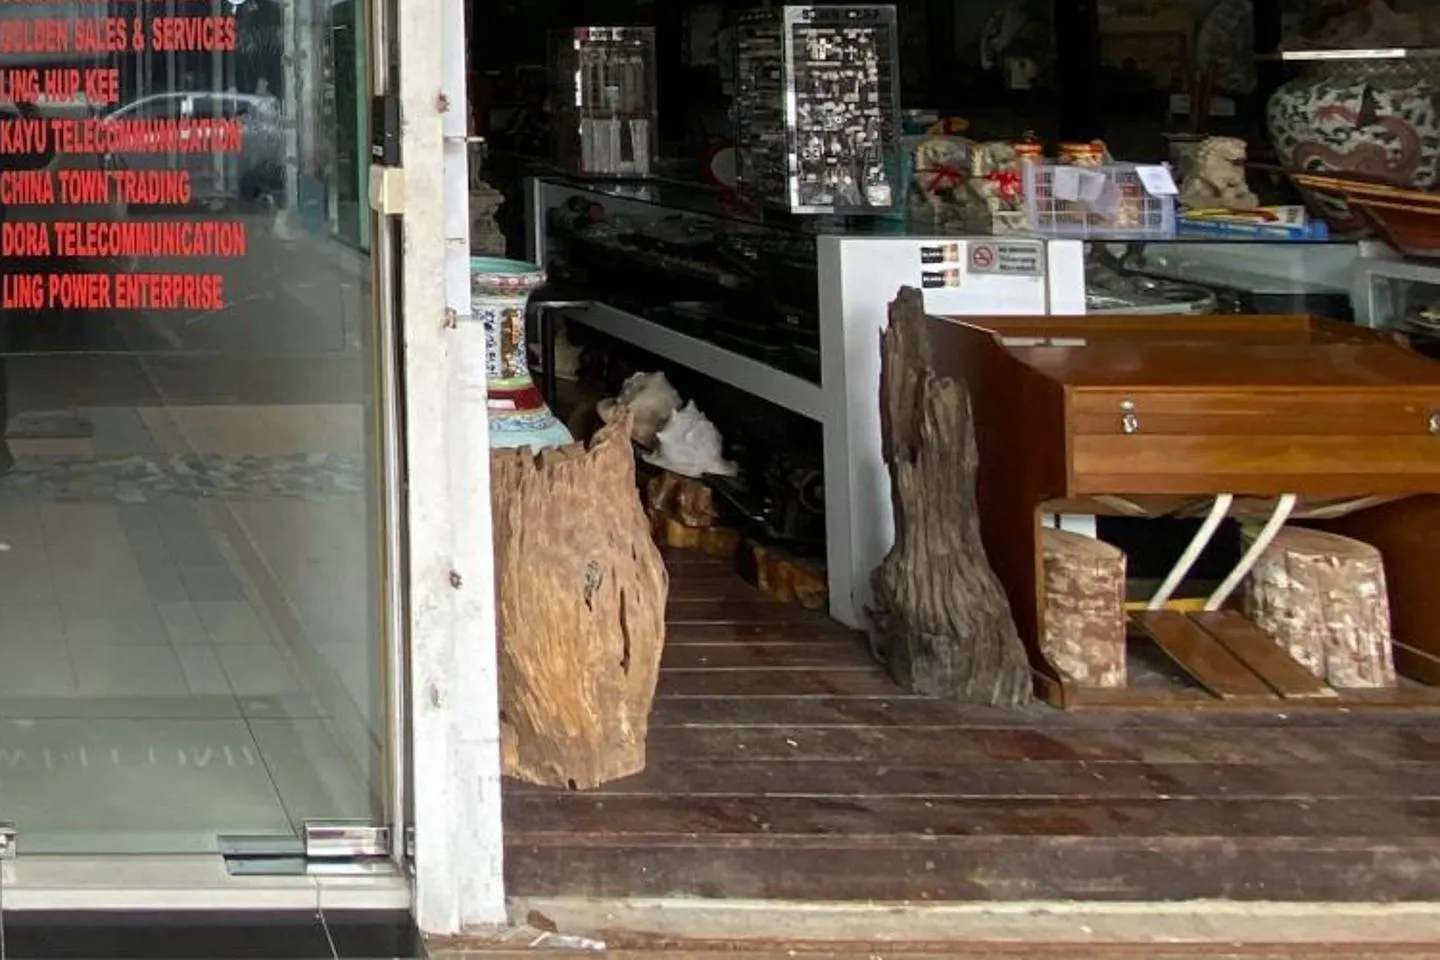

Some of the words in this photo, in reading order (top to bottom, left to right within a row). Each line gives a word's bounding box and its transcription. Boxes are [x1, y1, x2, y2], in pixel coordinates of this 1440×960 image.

[74, 18, 128, 52] SALES
[133, 19, 145, 51] &
[152, 17, 237, 52] SERVICES
[0, 69, 40, 103] LING
[44, 69, 81, 103] HUP
[85, 69, 120, 103] KEE
[0, 119, 47, 154] KAYU
[0, 170, 54, 204] CHINA
[59, 170, 109, 204] TOWN
[114, 170, 191, 204] TRADING
[2, 222, 50, 256] DORA
[54, 221, 246, 256] TELECOMMUNICATION
[3, 275, 44, 309] LING
[48, 274, 110, 309] POWER
[115, 274, 224, 309] ENTERPRISE
